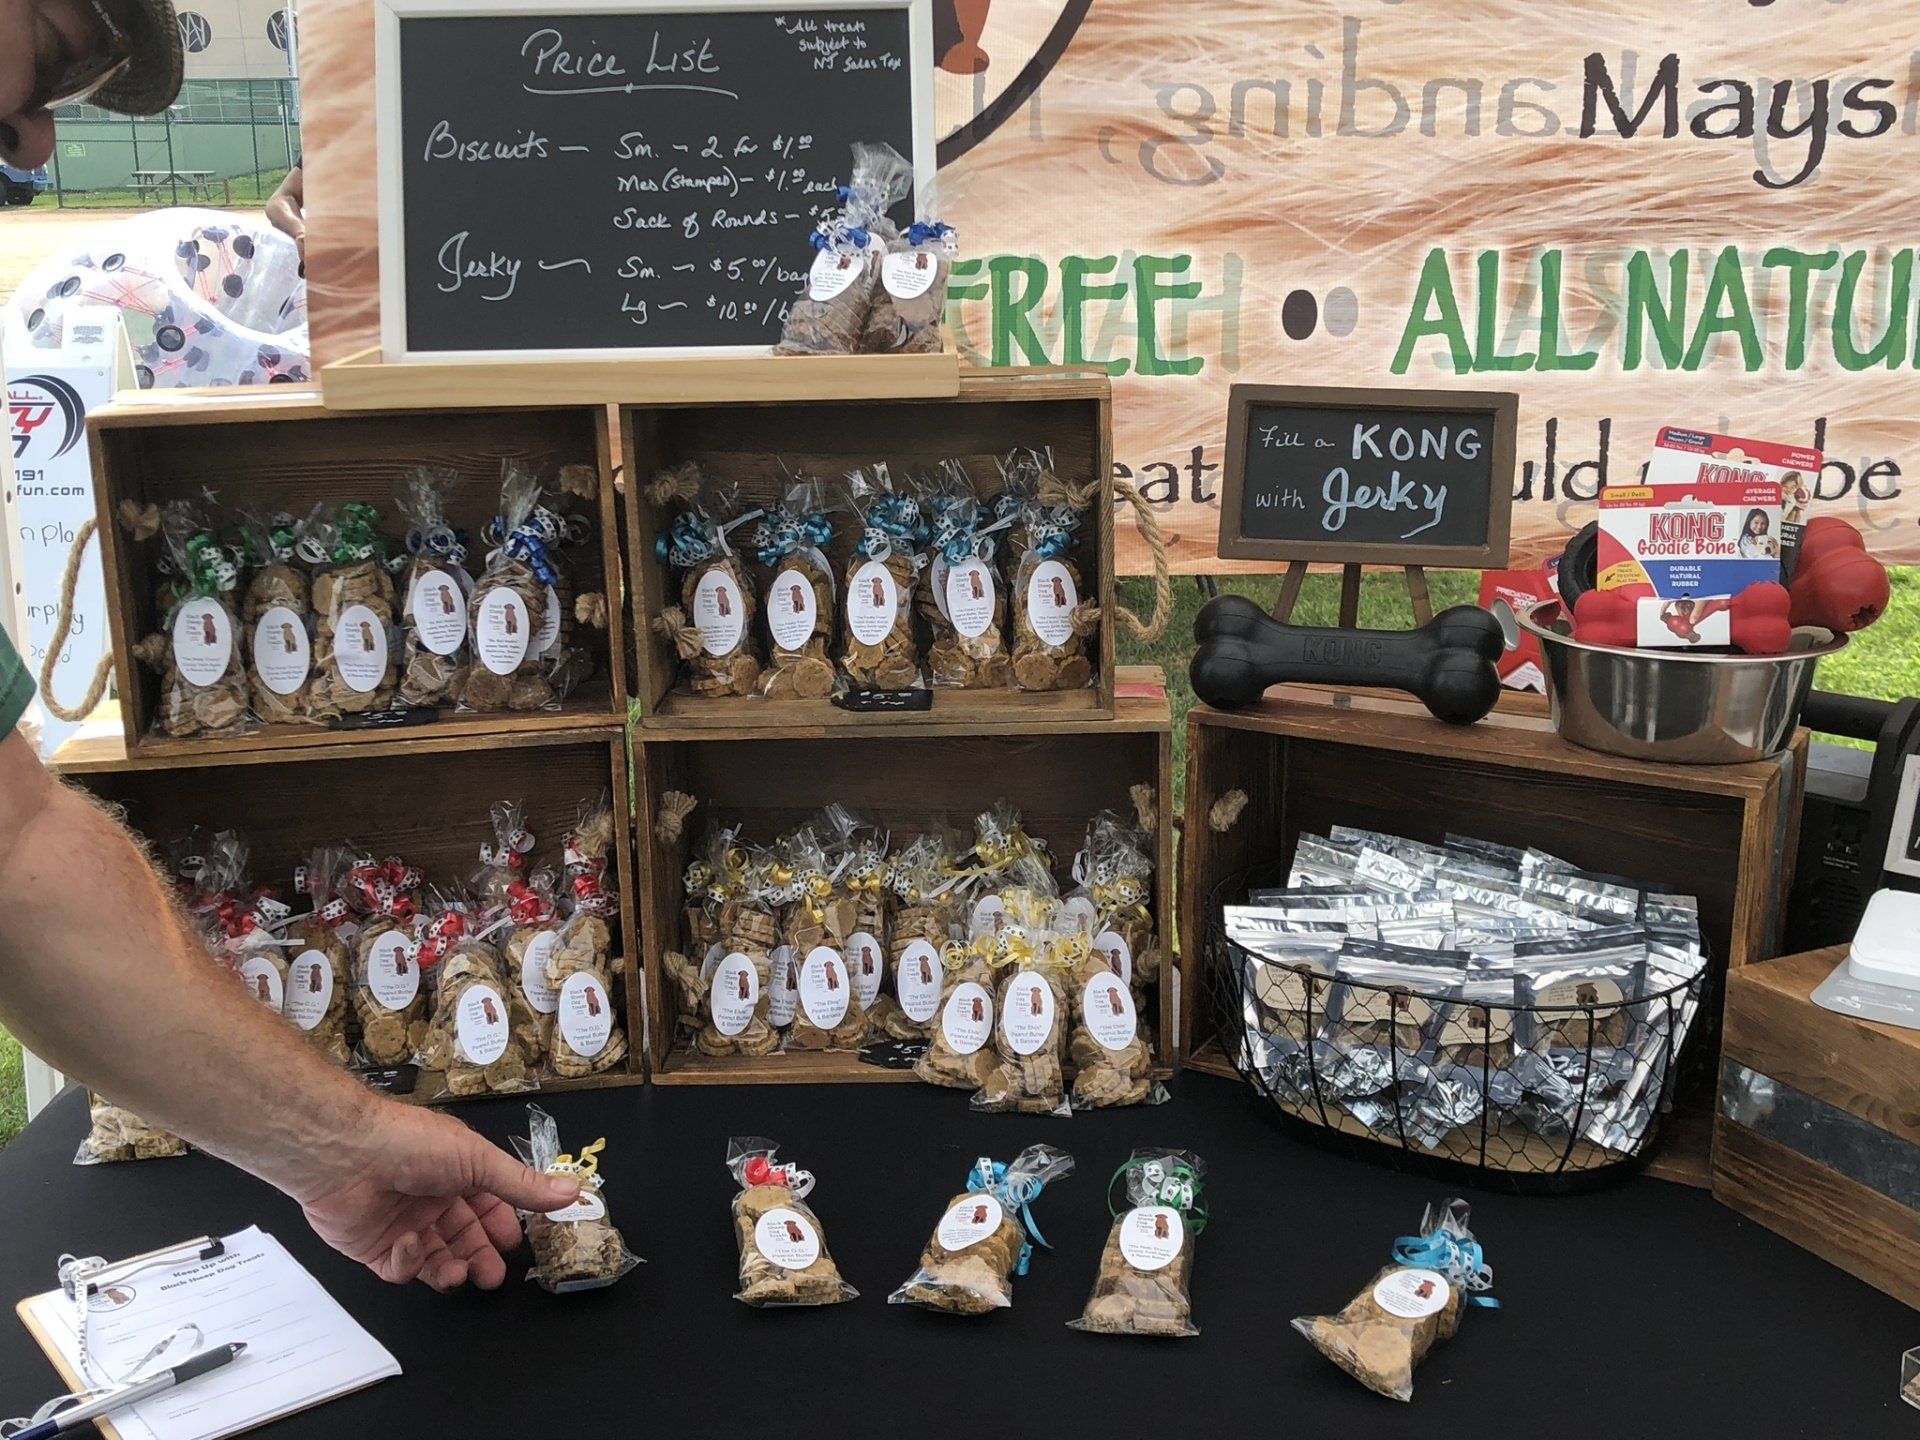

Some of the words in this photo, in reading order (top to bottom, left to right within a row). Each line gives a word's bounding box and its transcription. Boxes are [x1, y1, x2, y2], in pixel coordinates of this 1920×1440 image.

[824, 20, 865, 33] treats
[646, 30, 720, 74] List
[853, 36, 867, 49] to
[814, 51, 839, 70] NJ
[843, 56, 877, 72] Sales
[880, 52, 901, 71] Tax
[1579, 52, 1897, 189] Mays
[423, 121, 549, 162] Biscuits
[614, 131, 660, 159] Sm.
[701, 135, 724, 159] 2
[733, 135, 758, 158] for
[802, 177, 838, 194] each
[613, 207, 671, 230] Sack
[682, 211, 700, 239] of
[711, 208, 778, 229] Rounds
[437, 230, 522, 301] Jerky
[617, 256, 661, 279] Sm.
[621, 292, 648, 325] Lg
[1389, 246, 1600, 375] ALL
[1621, 245, 1920, 372] NATU
[1259, 425, 1305, 449] Fill
[1315, 437, 1335, 449] a
[1351, 423, 1482, 461] KONG
[1791, 452, 1815, 461] POWER
[1781, 458, 1814, 469] CHEWERS
[1256, 485, 1306, 509] with
[1321, 466, 1449, 539] Jerky
[1742, 494, 1776, 502] CHEWERS
[1745, 487, 1776, 495] AVERAGE
[1649, 511, 1726, 542] KONG
[1637, 538, 1690, 555] Goodie
[1695, 538, 1736, 555] Bone
[1303, 637, 1383, 666] KONG
[160, 1281, 187, 1291] Black
[188, 1272, 215, 1283] Sheep
[216, 1264, 236, 1274] Dog
[238, 1252, 265, 1266] Treats
[172, 1268, 199, 1278] Keep
[201, 1262, 217, 1271] Up
